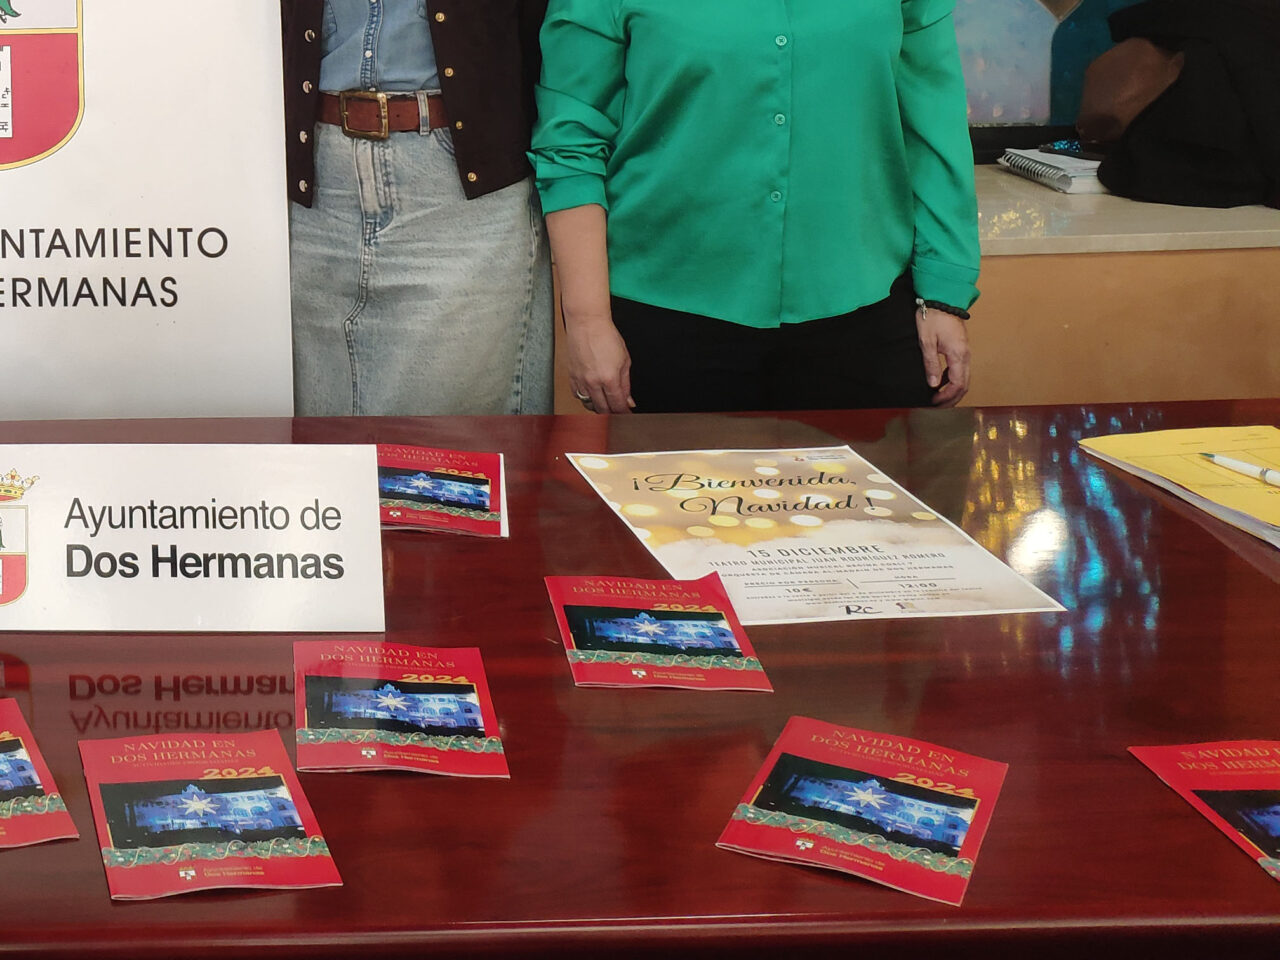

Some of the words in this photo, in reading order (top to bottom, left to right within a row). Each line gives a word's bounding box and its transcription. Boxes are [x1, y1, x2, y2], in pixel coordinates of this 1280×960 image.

[64, 496, 290, 536] Ayuntamiento
[299, 498, 342, 529] de
[745, 549, 772, 557] 15
[774, 544, 886, 556] DICIEMBRE
[66, 544, 139, 579] Dos
[152, 544, 345, 580] Hermanas
[585, 580, 656, 590] NAVIDAD
[573, 586, 605, 594] DOS
[610, 588, 701, 599] HERMANAS
[652, 603, 718, 612] 2024
[334, 645, 409, 657] NAVIDAD
[416, 651, 438, 659] EN
[320, 653, 354, 663] DOS
[359, 654, 455, 668] HERMANAS
[401, 673, 469, 683] 2024
[124, 740, 205, 752] NAVIDAD
[213, 740, 236, 748] EN
[833, 730, 920, 754] NAVIDAD
[928, 750, 955, 763] EN
[110, 753, 146, 764] DOS
[154, 749, 256, 761] HERMANAS
[810, 735, 850, 751] DOS
[856, 745, 969, 777] HERMANAS
[203, 766, 275, 778] 2024
[896, 773, 975, 796] 2024
